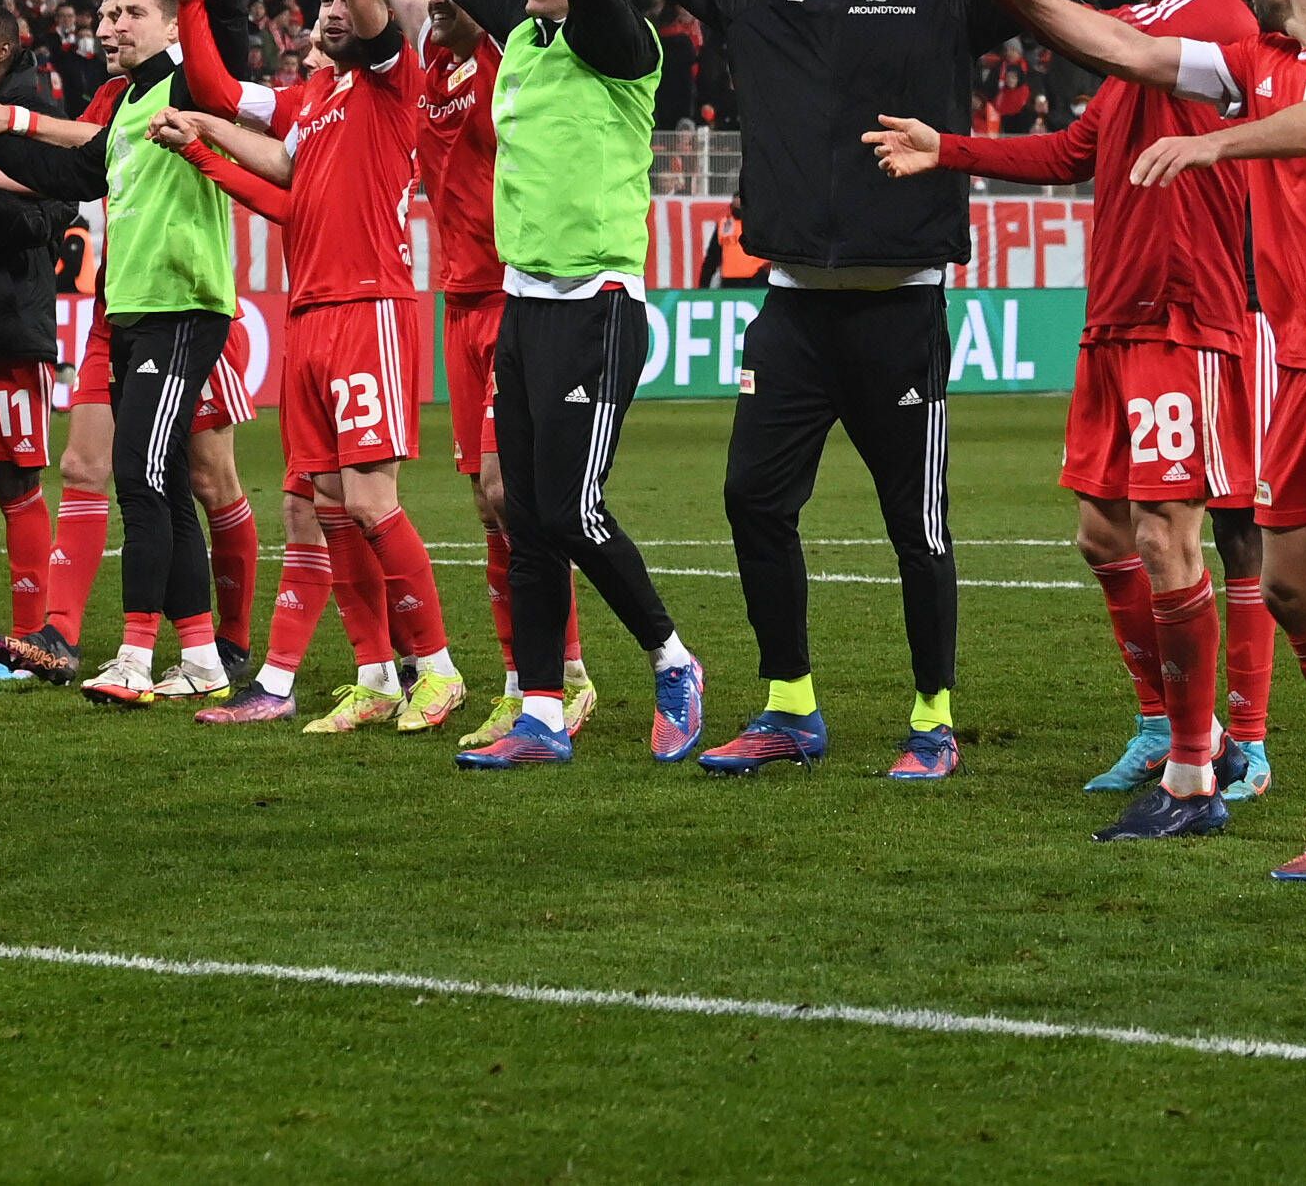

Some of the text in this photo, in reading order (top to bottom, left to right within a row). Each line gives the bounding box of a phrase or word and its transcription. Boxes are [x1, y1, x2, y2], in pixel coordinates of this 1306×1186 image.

[847, 5, 917, 15] AROUNDTOWN
[330, 372, 383, 434] 23
[897, 397, 923, 406] adidas
[1127, 391, 1196, 464] 28
